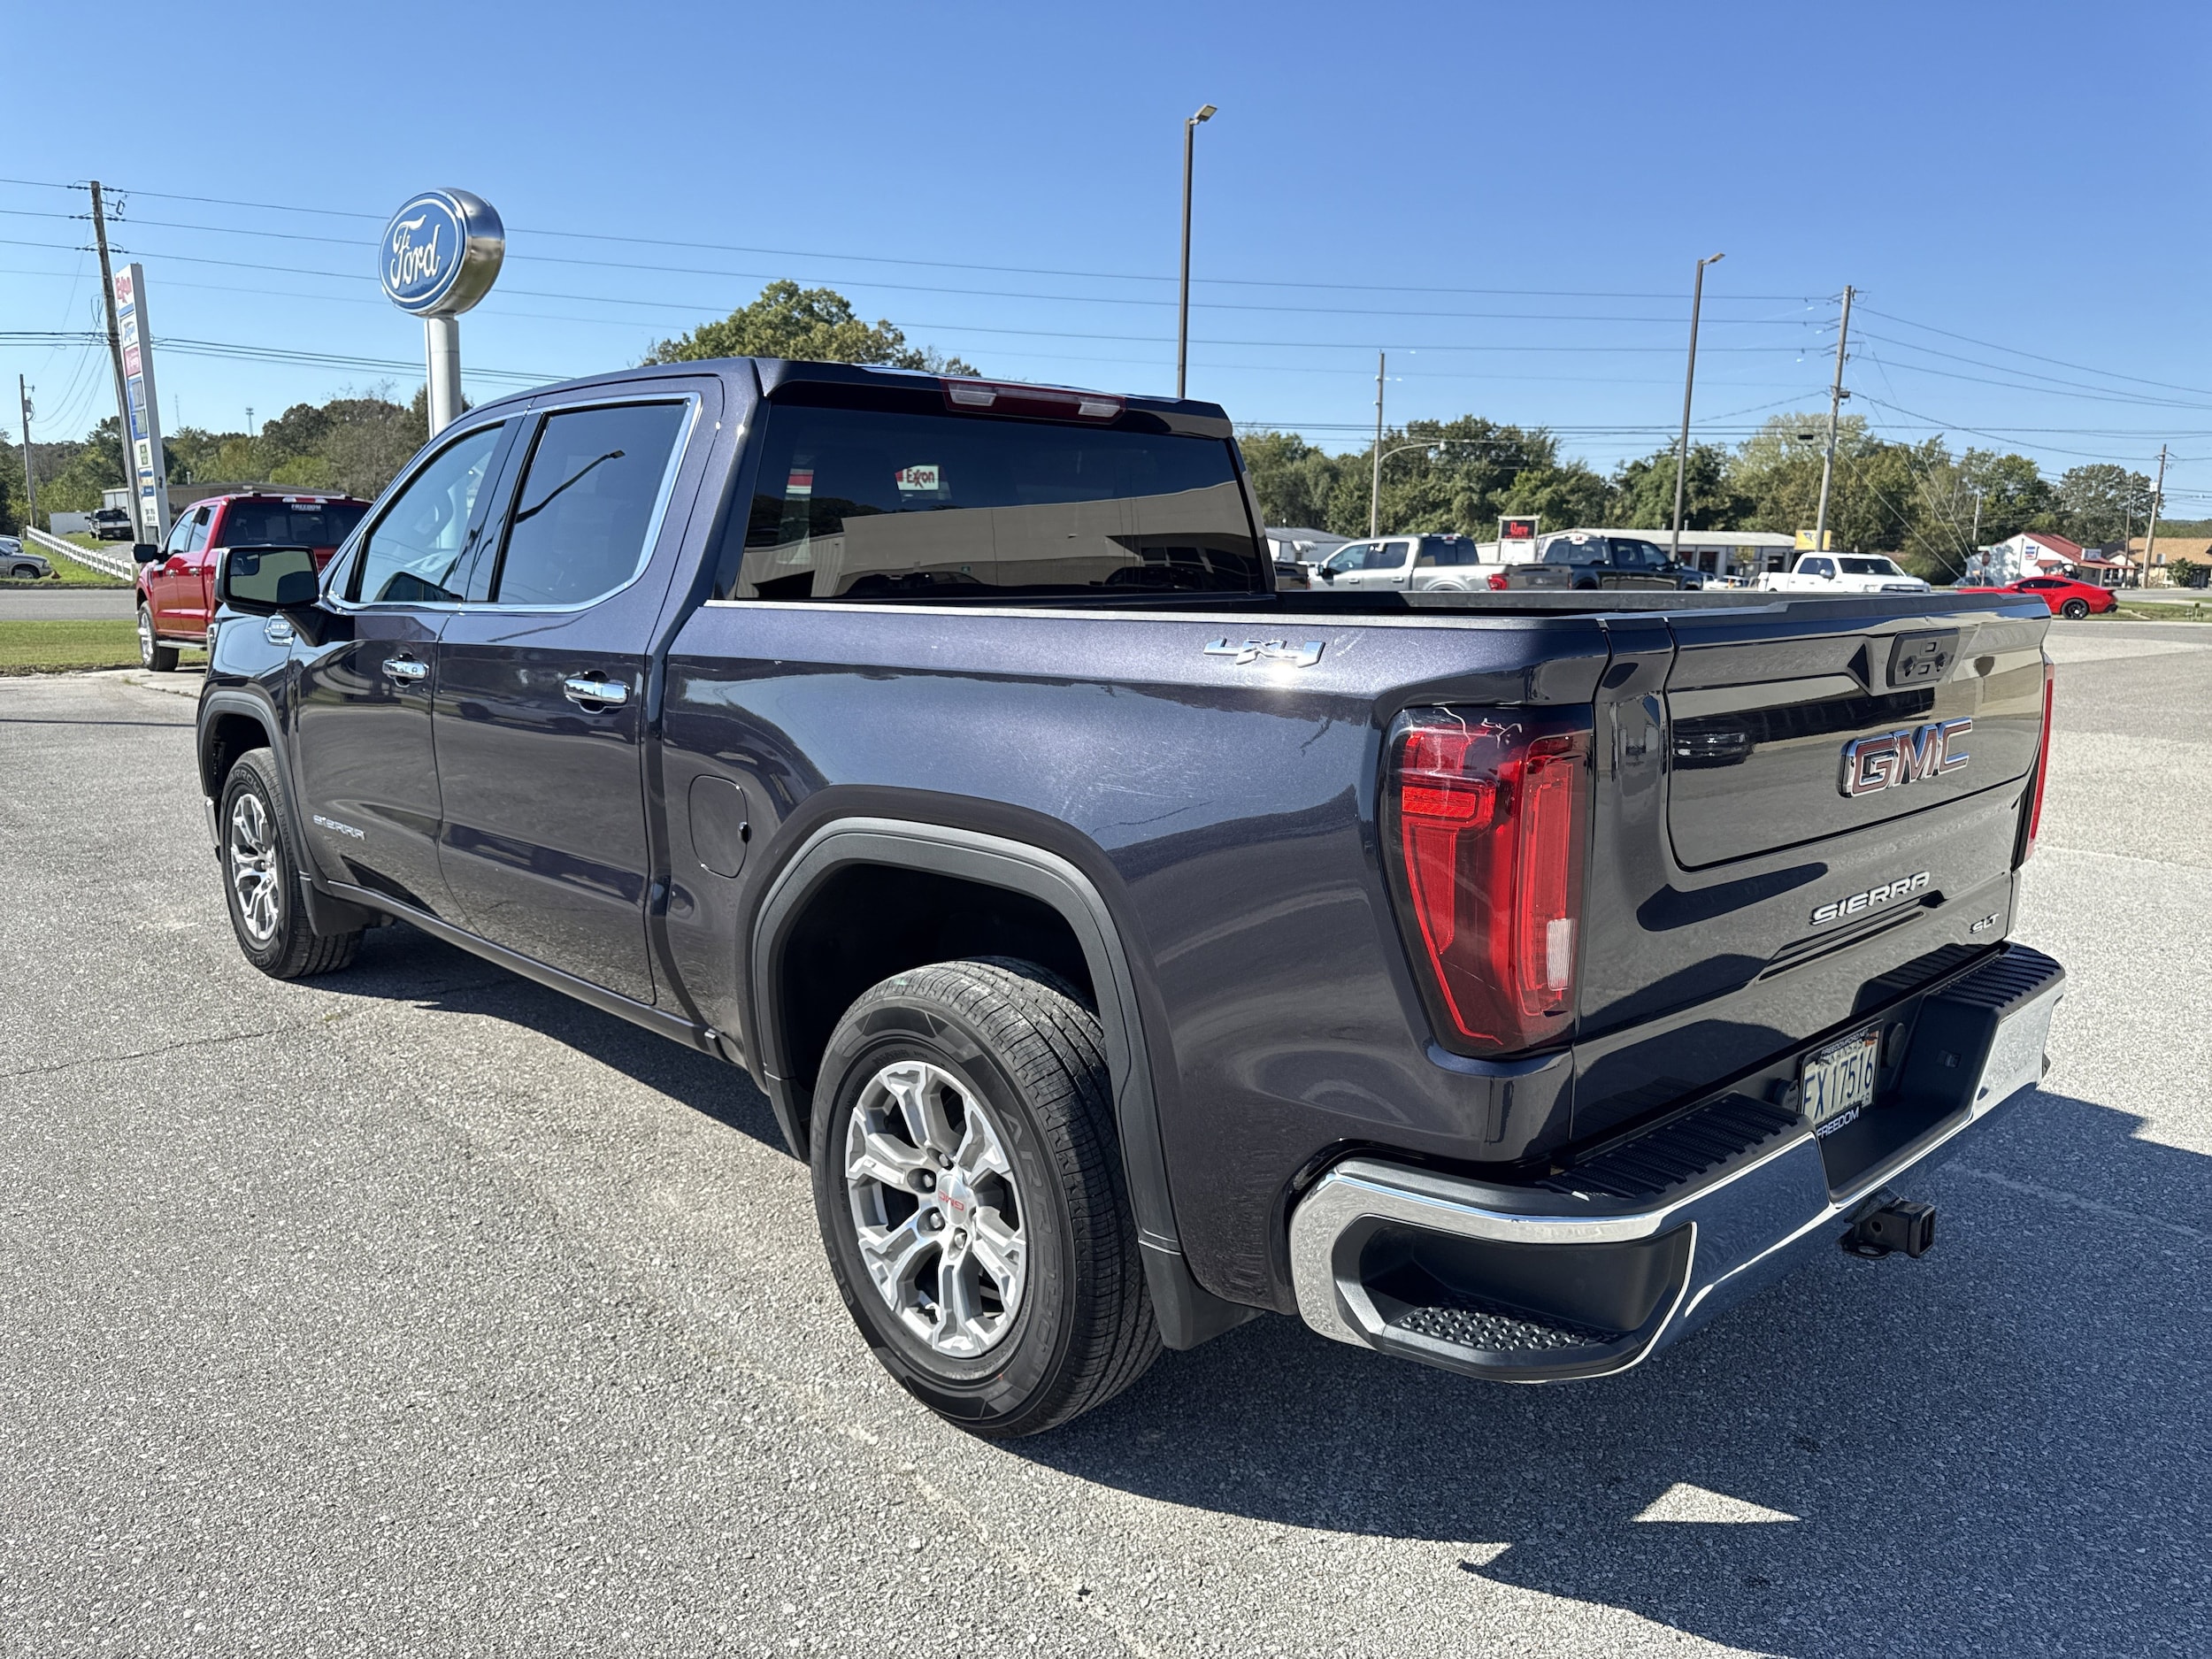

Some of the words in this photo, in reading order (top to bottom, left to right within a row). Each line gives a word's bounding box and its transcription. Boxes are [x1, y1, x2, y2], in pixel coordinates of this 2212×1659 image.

[389, 213, 442, 290] Ford
[906, 469, 935, 489] Exxon
[1838, 716, 1973, 798] GMC
[313, 815, 365, 841] SIERRA
[1809, 871, 1931, 926] SIERRA
[1970, 912, 2001, 934] SLT
[1816, 1106, 1859, 1139] FREEDOM
[938, 1188, 965, 1211] GMC
